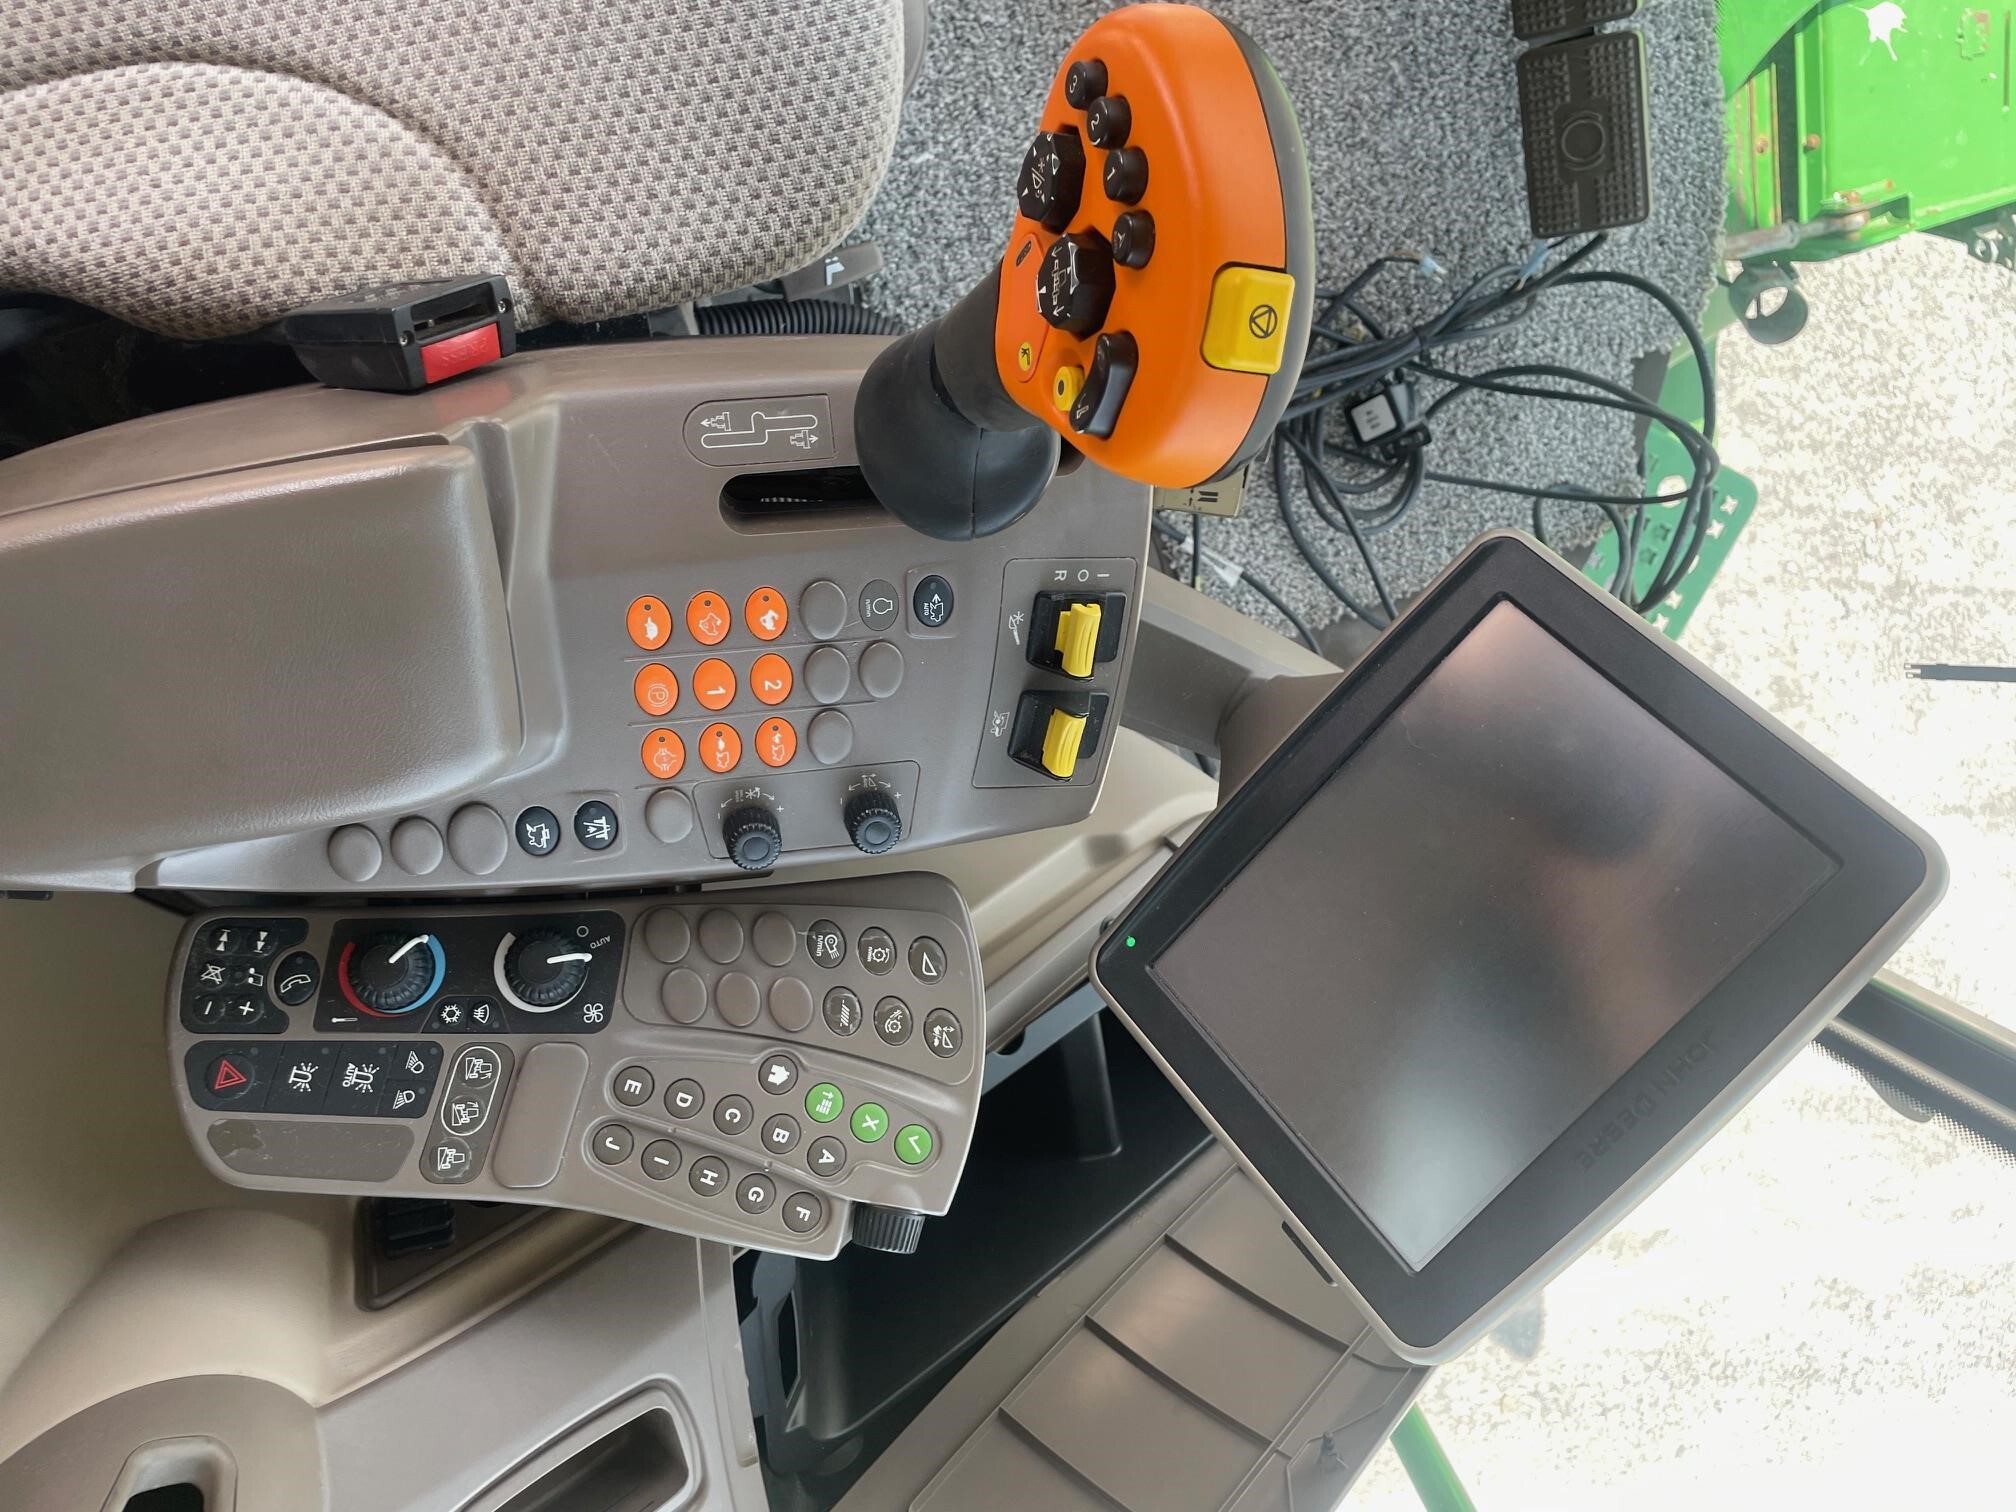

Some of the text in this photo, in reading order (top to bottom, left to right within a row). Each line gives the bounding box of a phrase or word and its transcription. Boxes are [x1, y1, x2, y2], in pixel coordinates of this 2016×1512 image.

[1054, 569, 1067, 583] R
[706, 686, 725, 696] 1
[764, 678, 782, 691] 2
[590, 935, 611, 950] AUTO
[342, 1062, 354, 1089] AUTO
[623, 1079, 643, 1095] E
[675, 1091, 694, 1108] D
[725, 1108, 742, 1123] C
[605, 1136, 620, 1151] J
[773, 1127, 790, 1144] B
[818, 1148, 836, 1164] A
[699, 1169, 719, 1186] H
[747, 1186, 765, 1203] G
[795, 1206, 811, 1222] F
